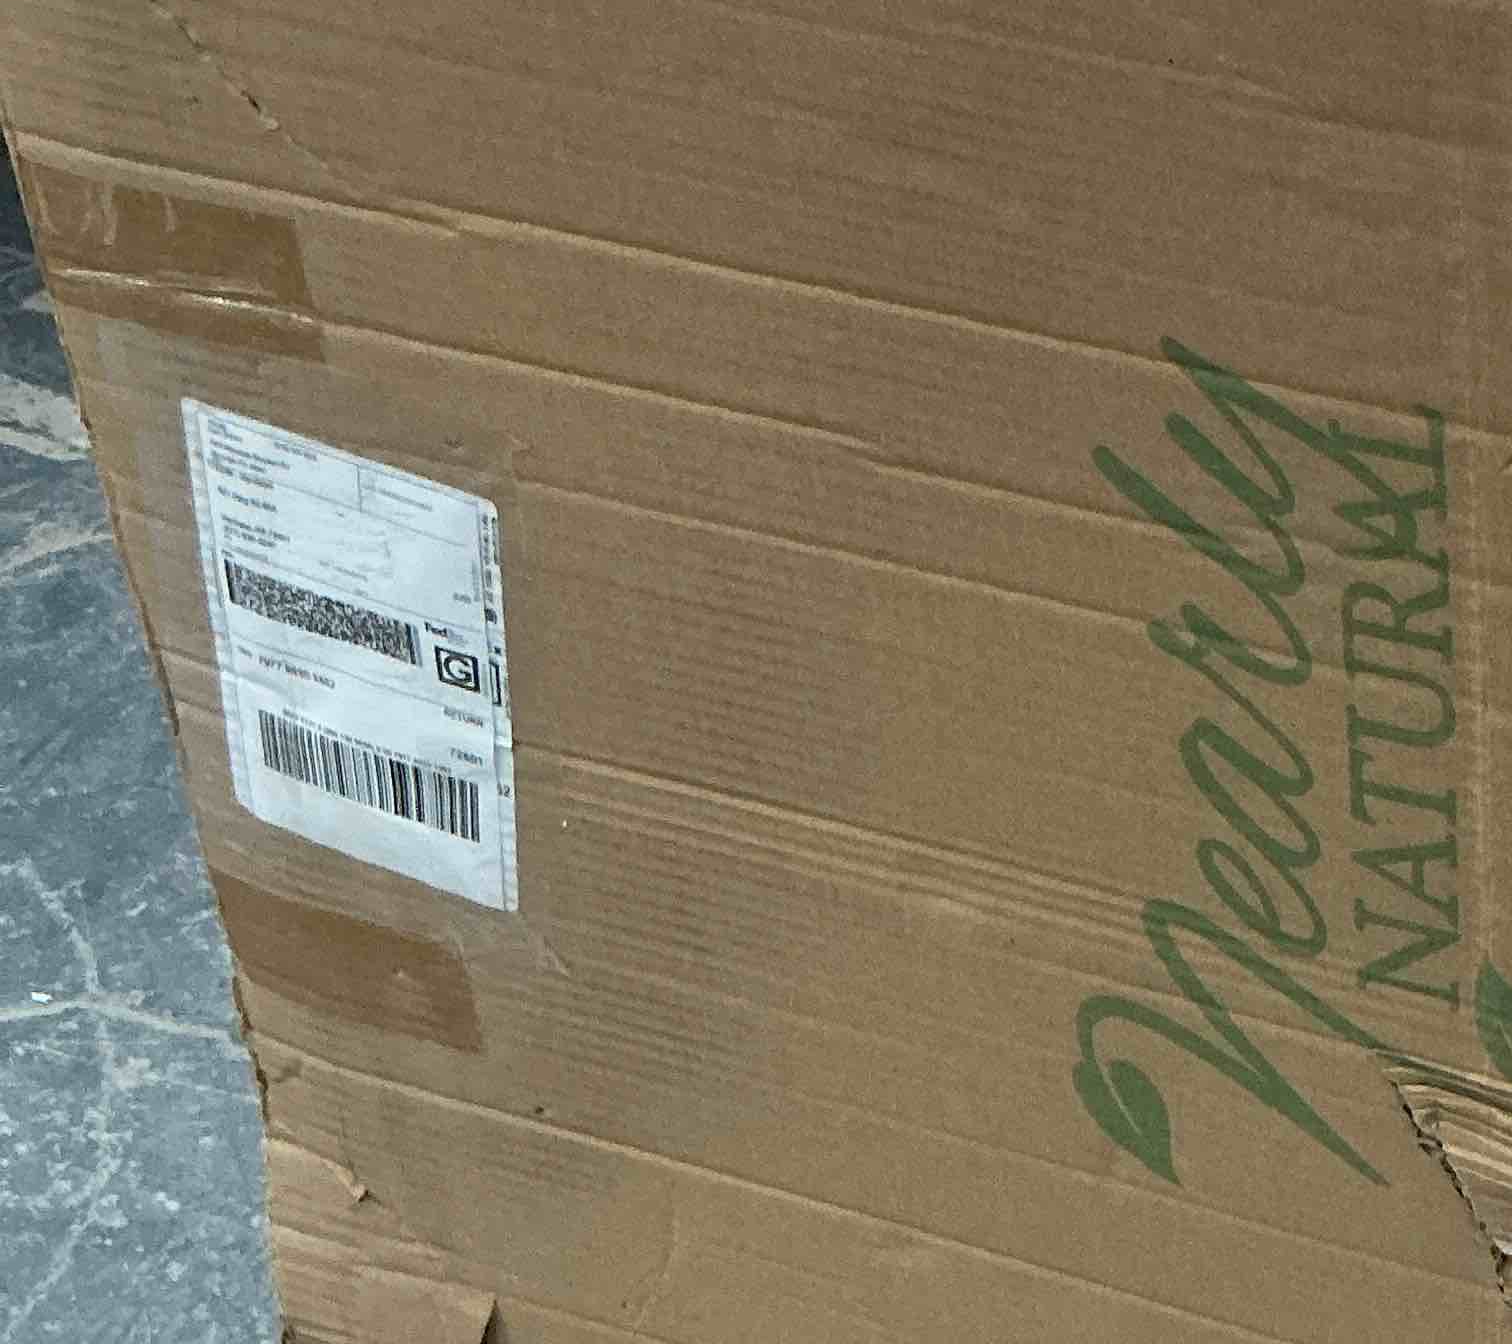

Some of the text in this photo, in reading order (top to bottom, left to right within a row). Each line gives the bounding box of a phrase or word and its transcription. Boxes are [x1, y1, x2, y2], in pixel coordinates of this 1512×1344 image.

[443, 656, 473, 684] G
[1073, 335, 1465, 1187] Nearly NATURAL
